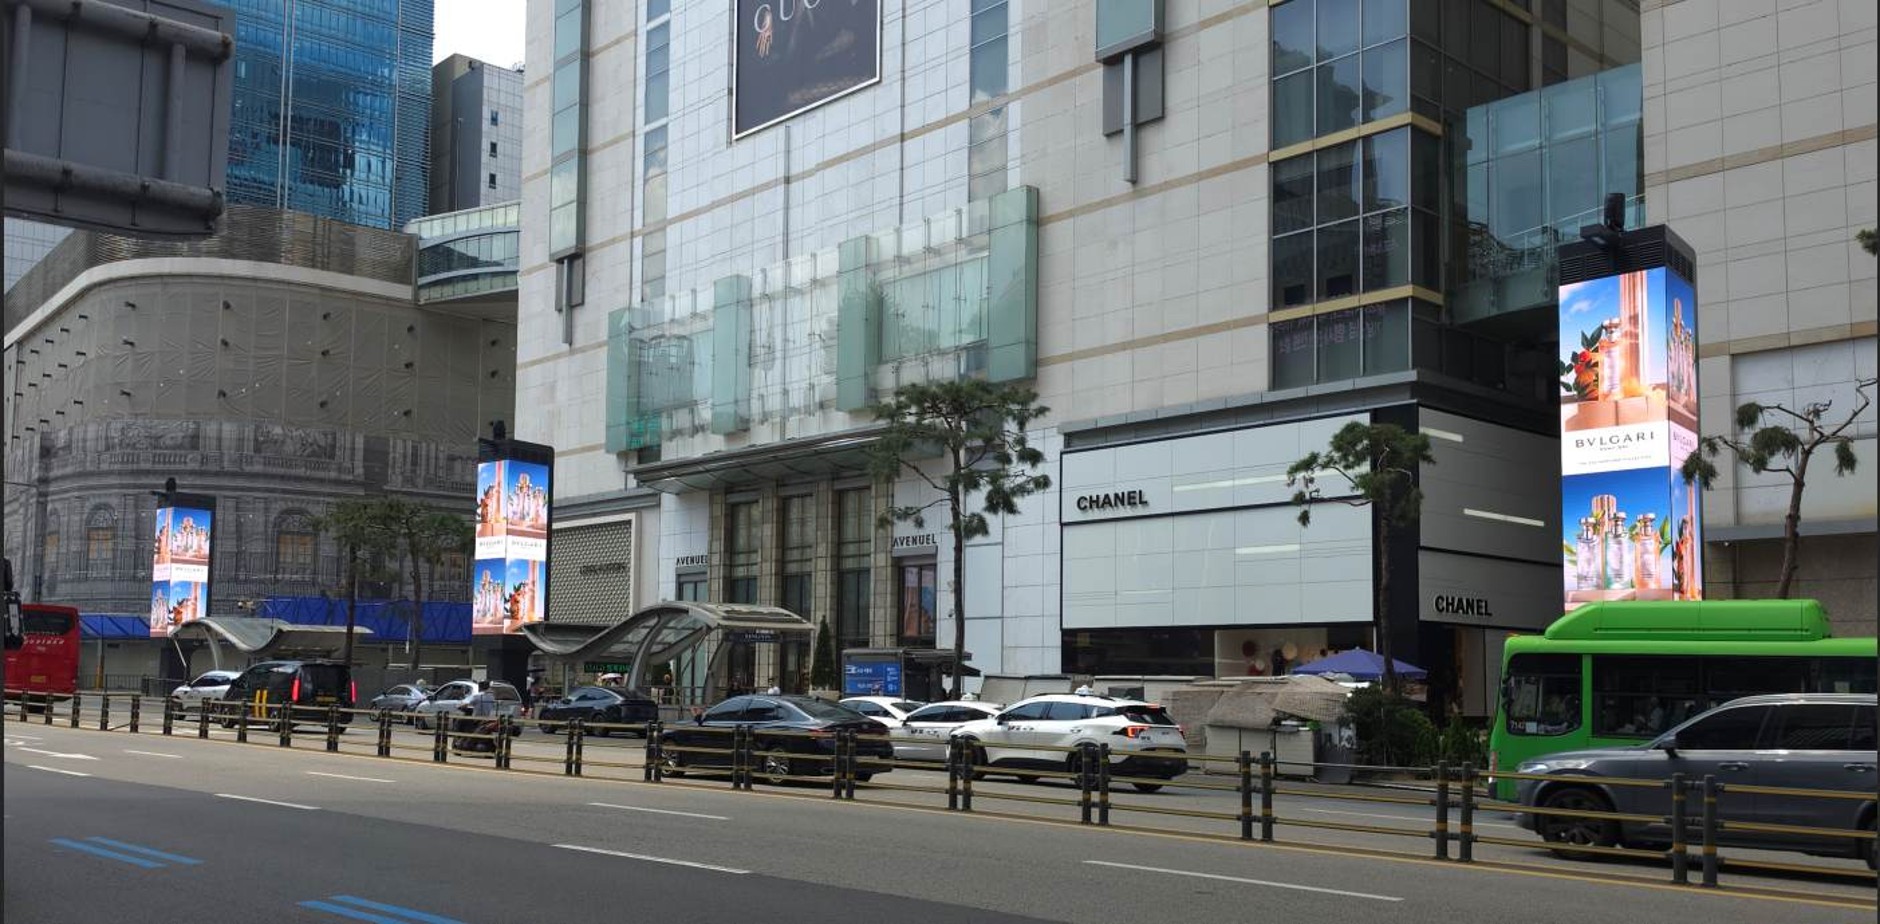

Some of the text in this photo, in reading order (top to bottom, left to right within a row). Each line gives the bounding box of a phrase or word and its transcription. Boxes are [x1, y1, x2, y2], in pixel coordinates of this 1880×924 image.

[1575, 431, 1655, 449] BVLGARI
[1076, 489, 1148, 511] CHANEL
[893, 533, 937, 547] AVENUEL
[1434, 595, 1493, 617] CHANEL
